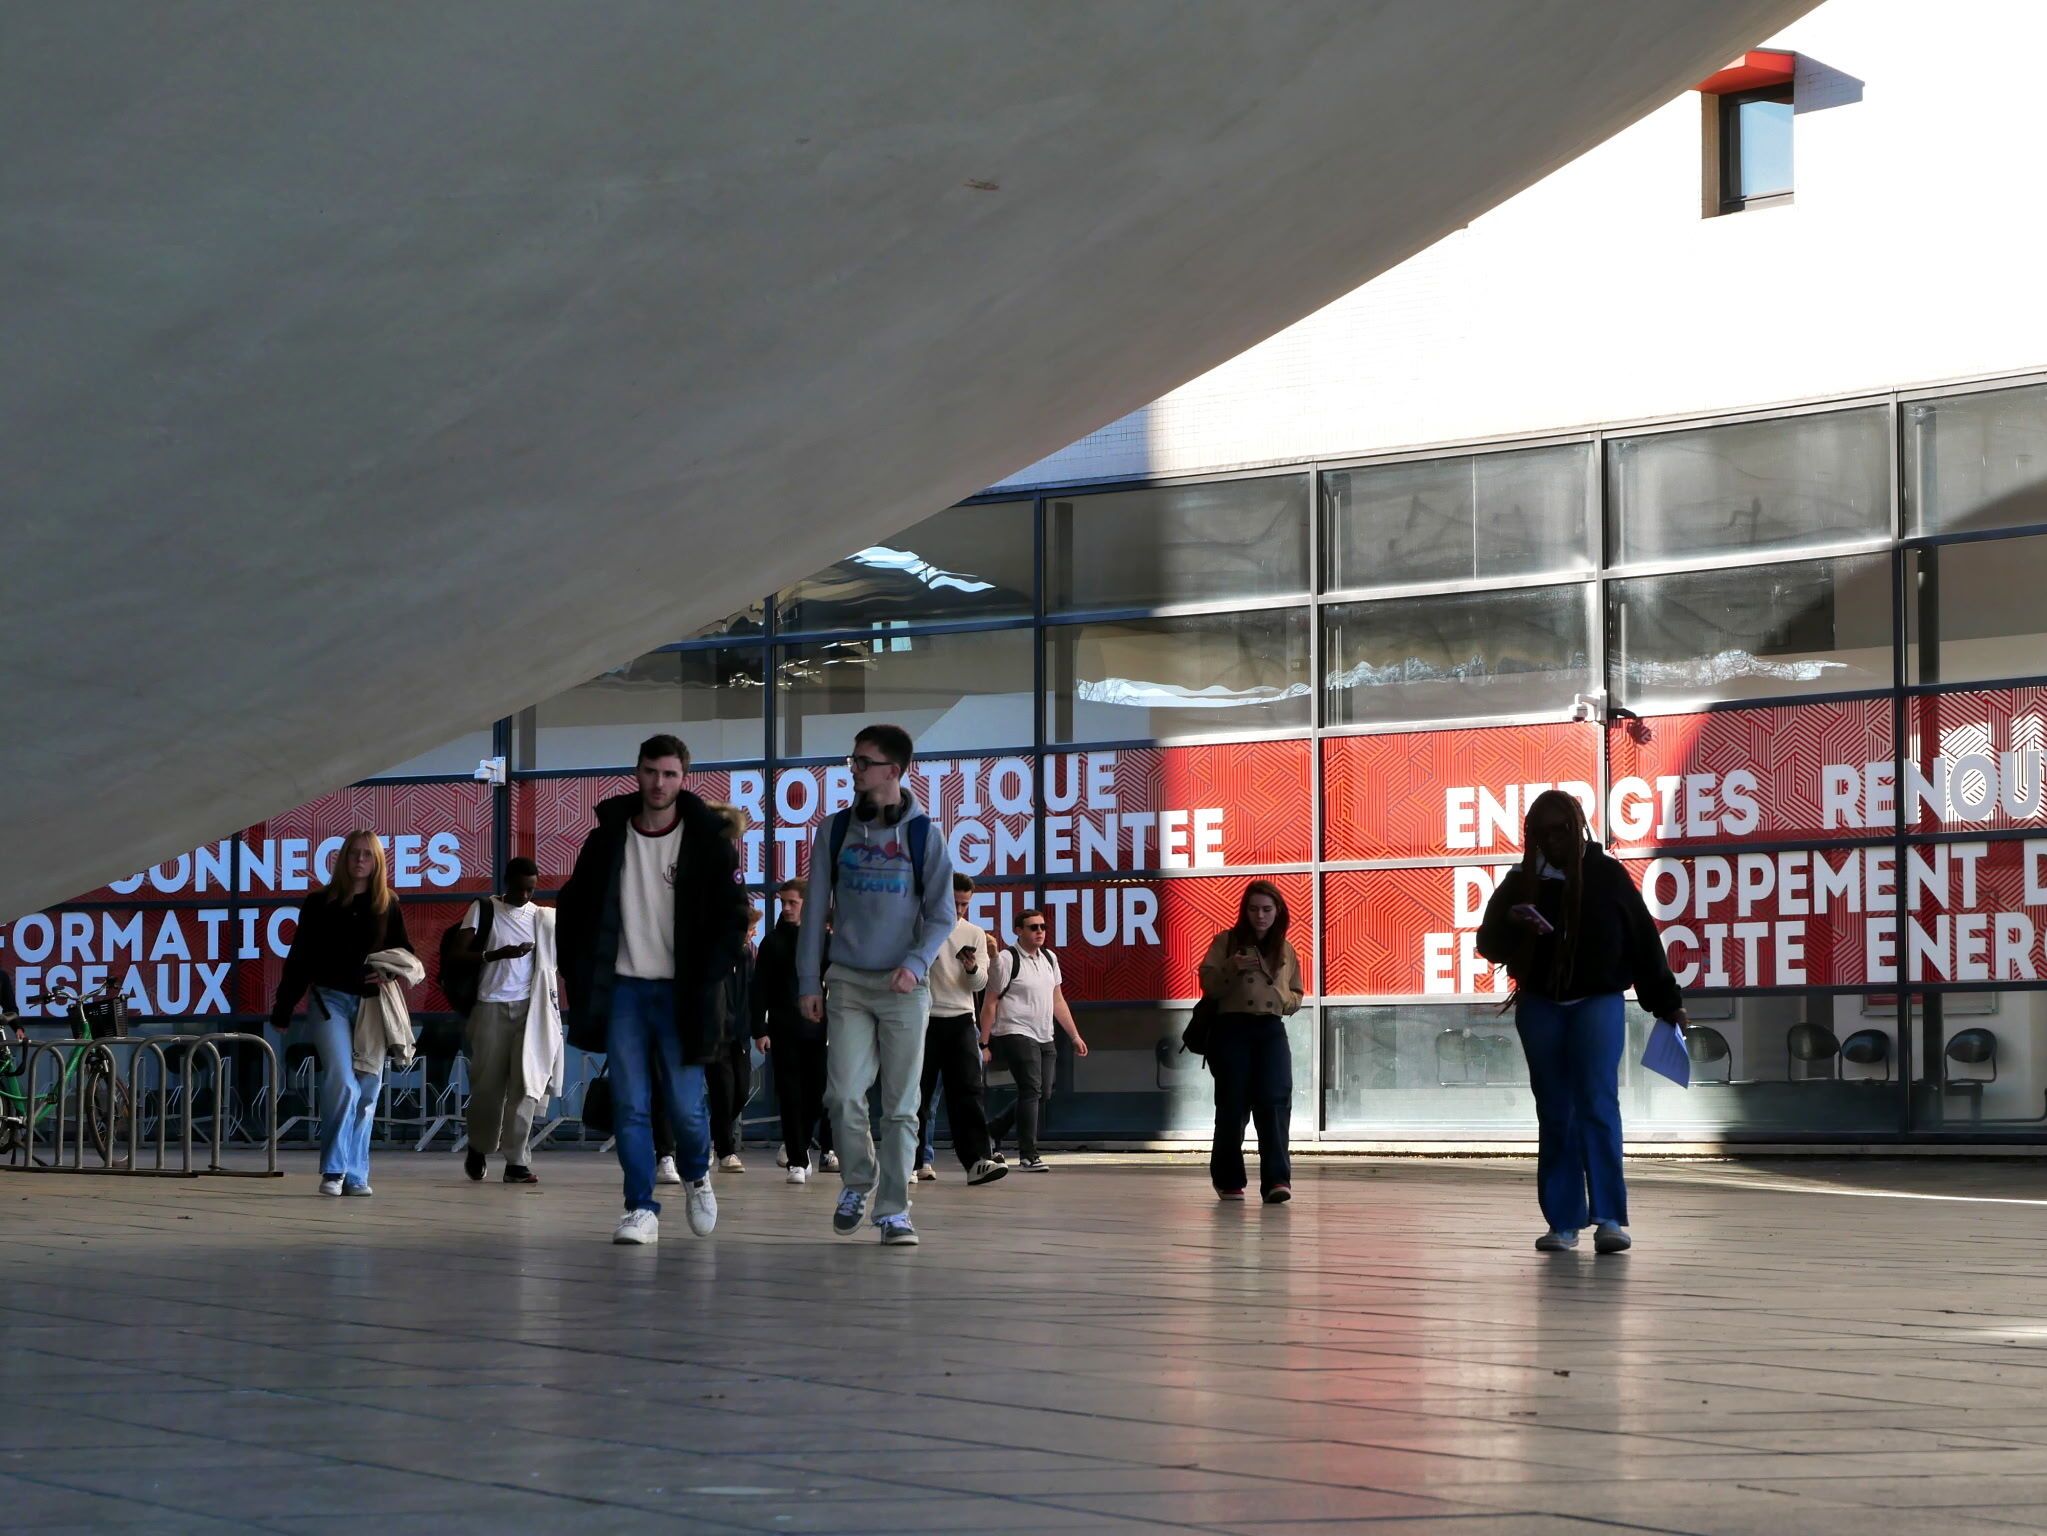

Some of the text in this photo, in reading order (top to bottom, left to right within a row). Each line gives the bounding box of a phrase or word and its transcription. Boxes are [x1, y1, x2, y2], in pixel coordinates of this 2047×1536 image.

[730, 752, 1116, 823] ROBTIQUE
[1823, 750, 2047, 831] RENOU
[108, 832, 462, 894] ONNECES
[1866, 911, 2047, 983] ENER
